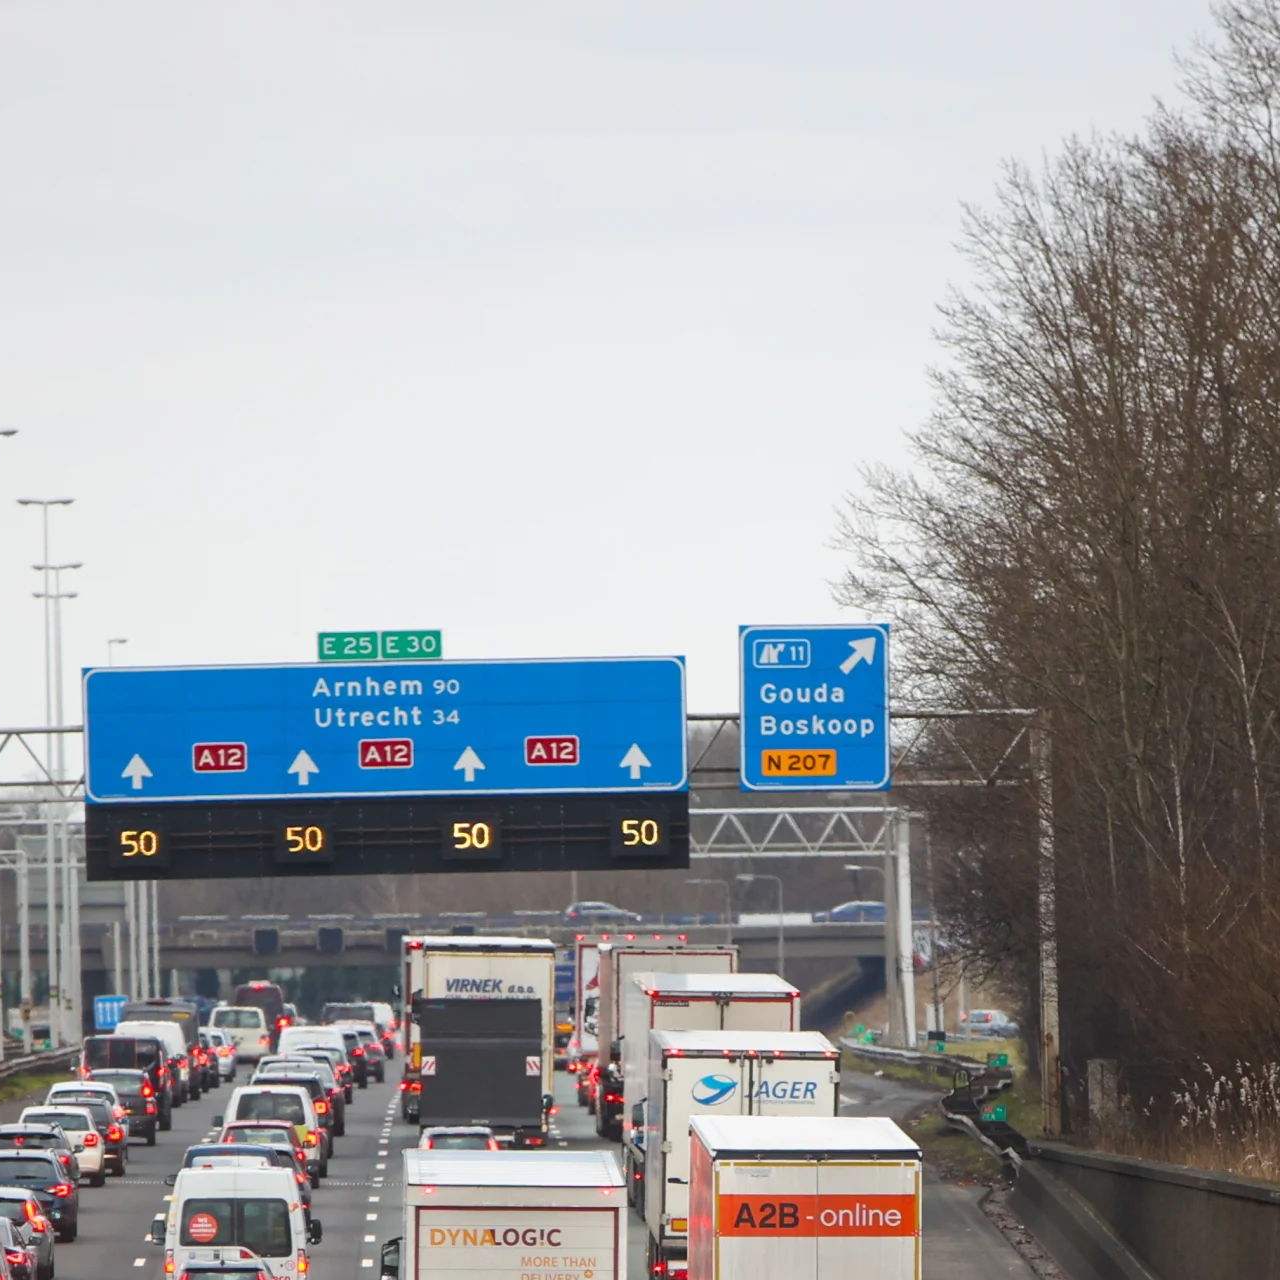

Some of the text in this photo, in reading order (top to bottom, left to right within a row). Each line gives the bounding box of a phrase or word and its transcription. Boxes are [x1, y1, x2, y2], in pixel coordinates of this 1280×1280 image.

[323, 638, 373, 654] E 25
[386, 635, 437, 653] E 30
[790, 646, 804, 661] 11
[312, 676, 460, 697] Arnhem 90
[760, 683, 845, 704] Gouda
[315, 706, 460, 727] Utrecht 34
[760, 715, 875, 738] Boskoop
[198, 748, 242, 766] A12
[365, 745, 408, 763] A12
[530, 742, 574, 760] A12
[767, 754, 831, 771] N 207
[286, 826, 324, 853] 50
[453, 822, 490, 849] 50
[621, 819, 659, 846] 50
[120, 830, 158, 857] 50
[445, 979, 535, 994] VIRNEK d.o.o.
[734, 1203, 800, 1228] A2B
[820, 1203, 902, 1227] online
[521, 1257, 596, 1267] MORE THAN
